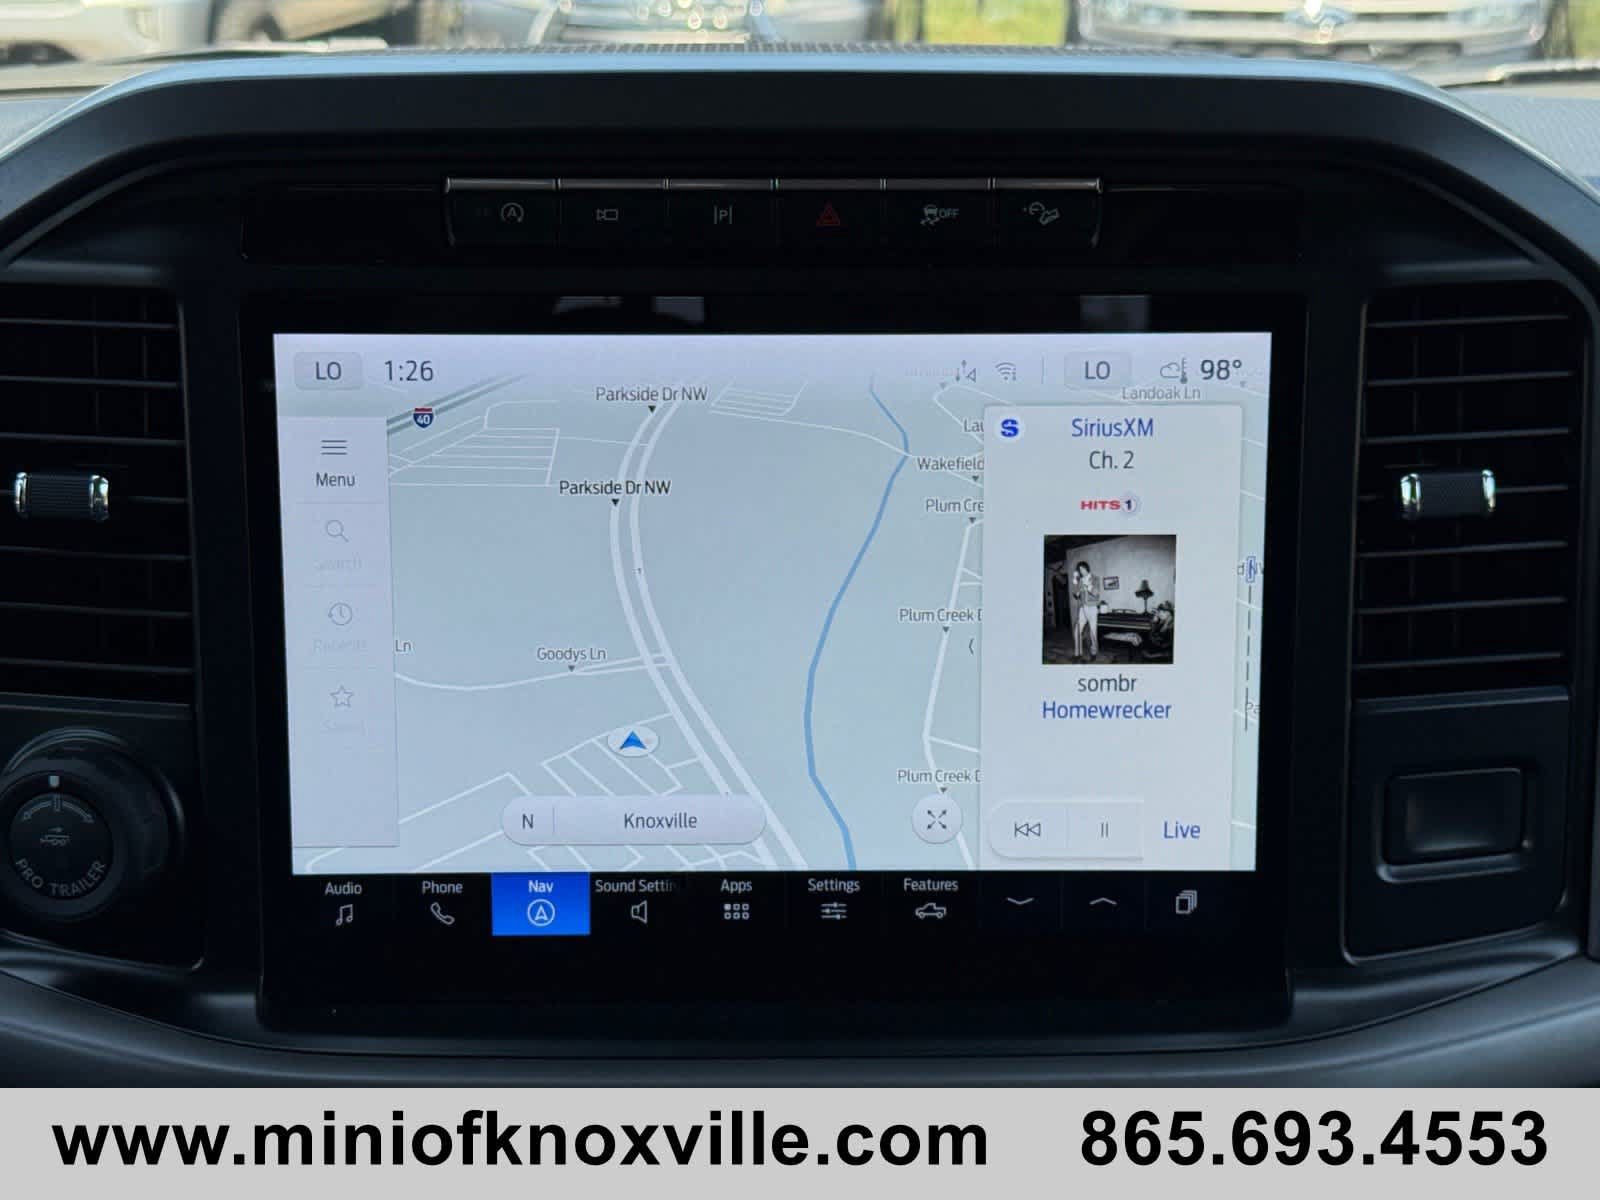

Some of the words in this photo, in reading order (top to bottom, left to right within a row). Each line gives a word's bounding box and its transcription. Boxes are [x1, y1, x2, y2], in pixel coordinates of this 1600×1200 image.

[939, 207, 960, 219] OFF
[315, 361, 343, 380] LO
[384, 360, 434, 382] 1:26
[1084, 360, 1111, 380] LO
[1200, 358, 1243, 381] 98°
[595, 386, 659, 402] Parkside
[662, 386, 680, 402] Dr
[680, 386, 708, 402] NW
[1122, 386, 1180, 401] Landoak
[1184, 386, 1201, 401] Ln
[417, 414, 431, 425] 40
[1071, 418, 1154, 438] SiriusXM
[917, 457, 984, 471] Wakefield
[1088, 451, 1119, 470] Ch.
[1123, 451, 1135, 470] 2
[316, 473, 356, 487] Menu
[559, 480, 623, 496] Parkside
[625, 480, 643, 495] Dr
[644, 480, 672, 495] NW
[926, 498, 961, 512] Plum
[1080, 500, 1121, 511] HITS
[899, 608, 935, 622] Plum
[937, 608, 974, 622] Creek
[395, 639, 412, 653] Ln
[536, 647, 586, 663] Goodys
[589, 647, 607, 661] Ln
[1077, 673, 1137, 693] sombr
[1042, 701, 1172, 720] Homewrecker
[897, 769, 932, 783] Plum
[935, 769, 971, 783] Creek
[521, 813, 535, 829] N
[623, 811, 698, 829] Knoxville
[1163, 820, 1201, 840] Live
[15, 857, 44, 889] PRO
[48, 860, 106, 897] TRAILER
[903, 878, 958, 892] Features
[324, 880, 363, 896] Audio
[422, 880, 463, 895] Phone
[528, 880, 554, 894] Nav
[595, 879, 633, 894] Sound
[720, 878, 753, 896] Apps
[807, 878, 861, 895] Settings
